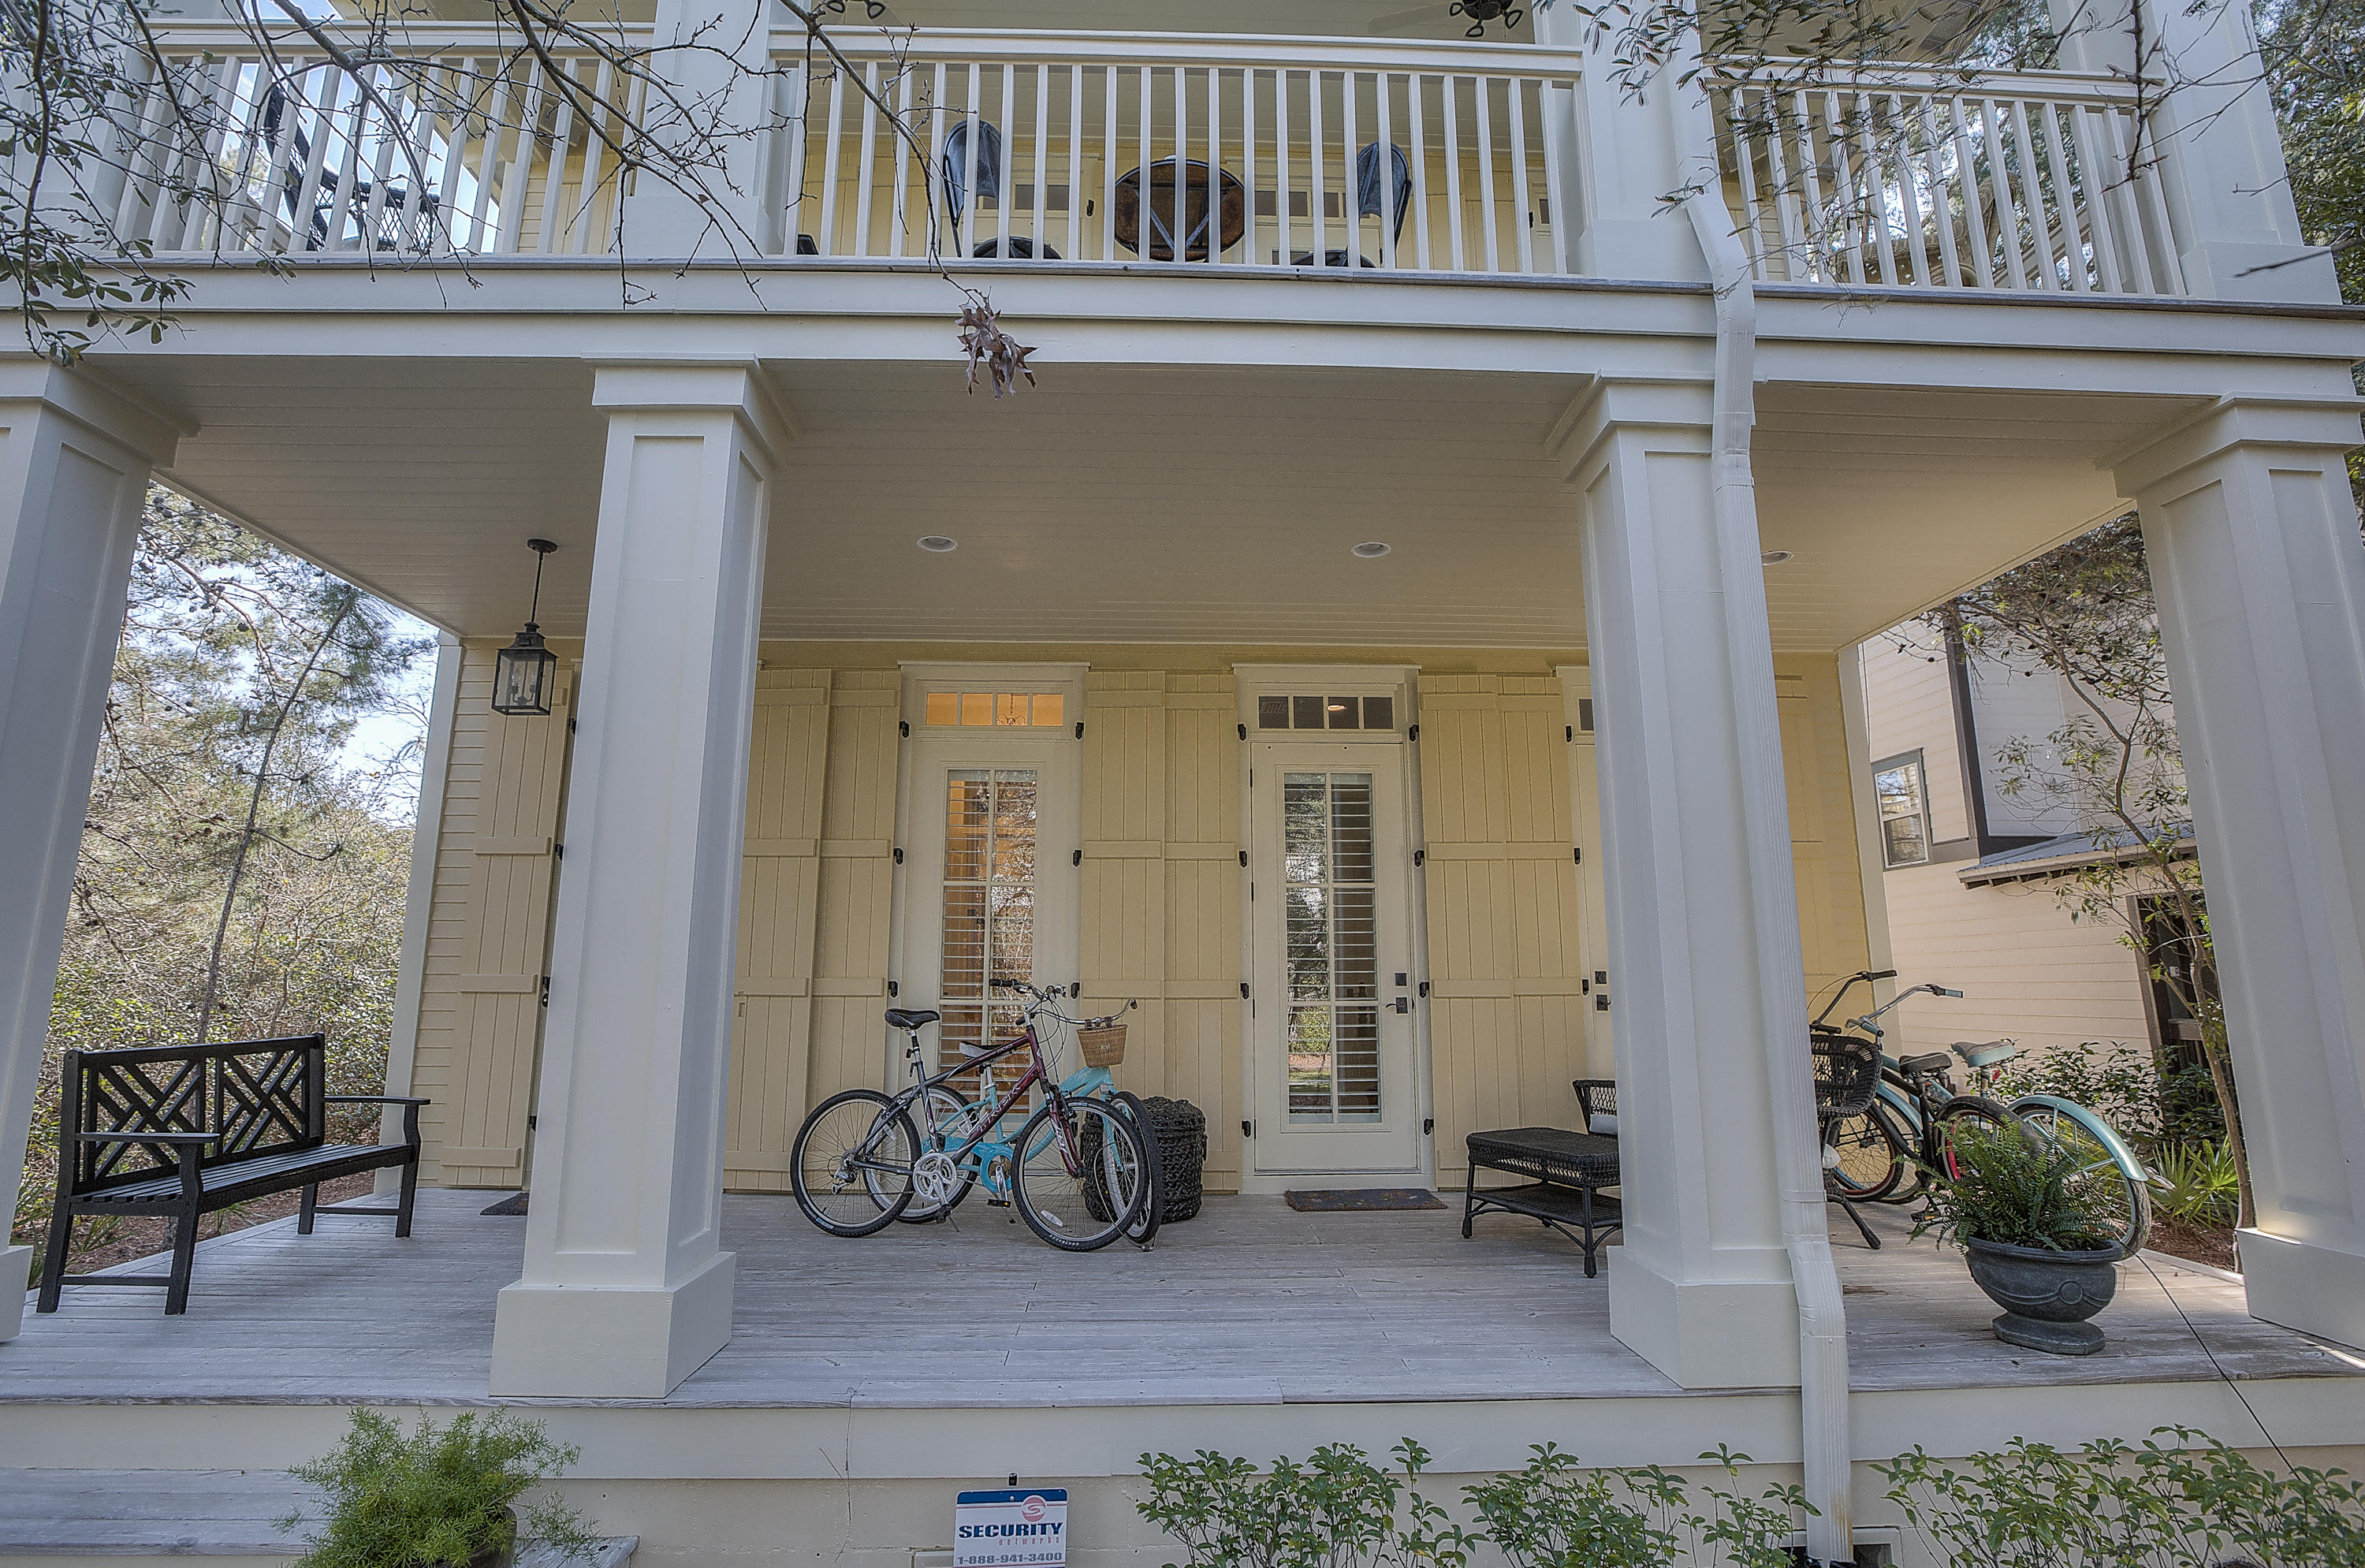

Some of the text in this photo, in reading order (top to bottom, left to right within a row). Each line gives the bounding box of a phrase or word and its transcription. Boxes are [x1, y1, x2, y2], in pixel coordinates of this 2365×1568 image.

[978, 1082, 1021, 1132] TREK
[959, 1521, 1063, 1539] SECURITY
[999, 1536, 1060, 1546] networks
[957, 1552, 1063, 1565] 1-888-941-3400
